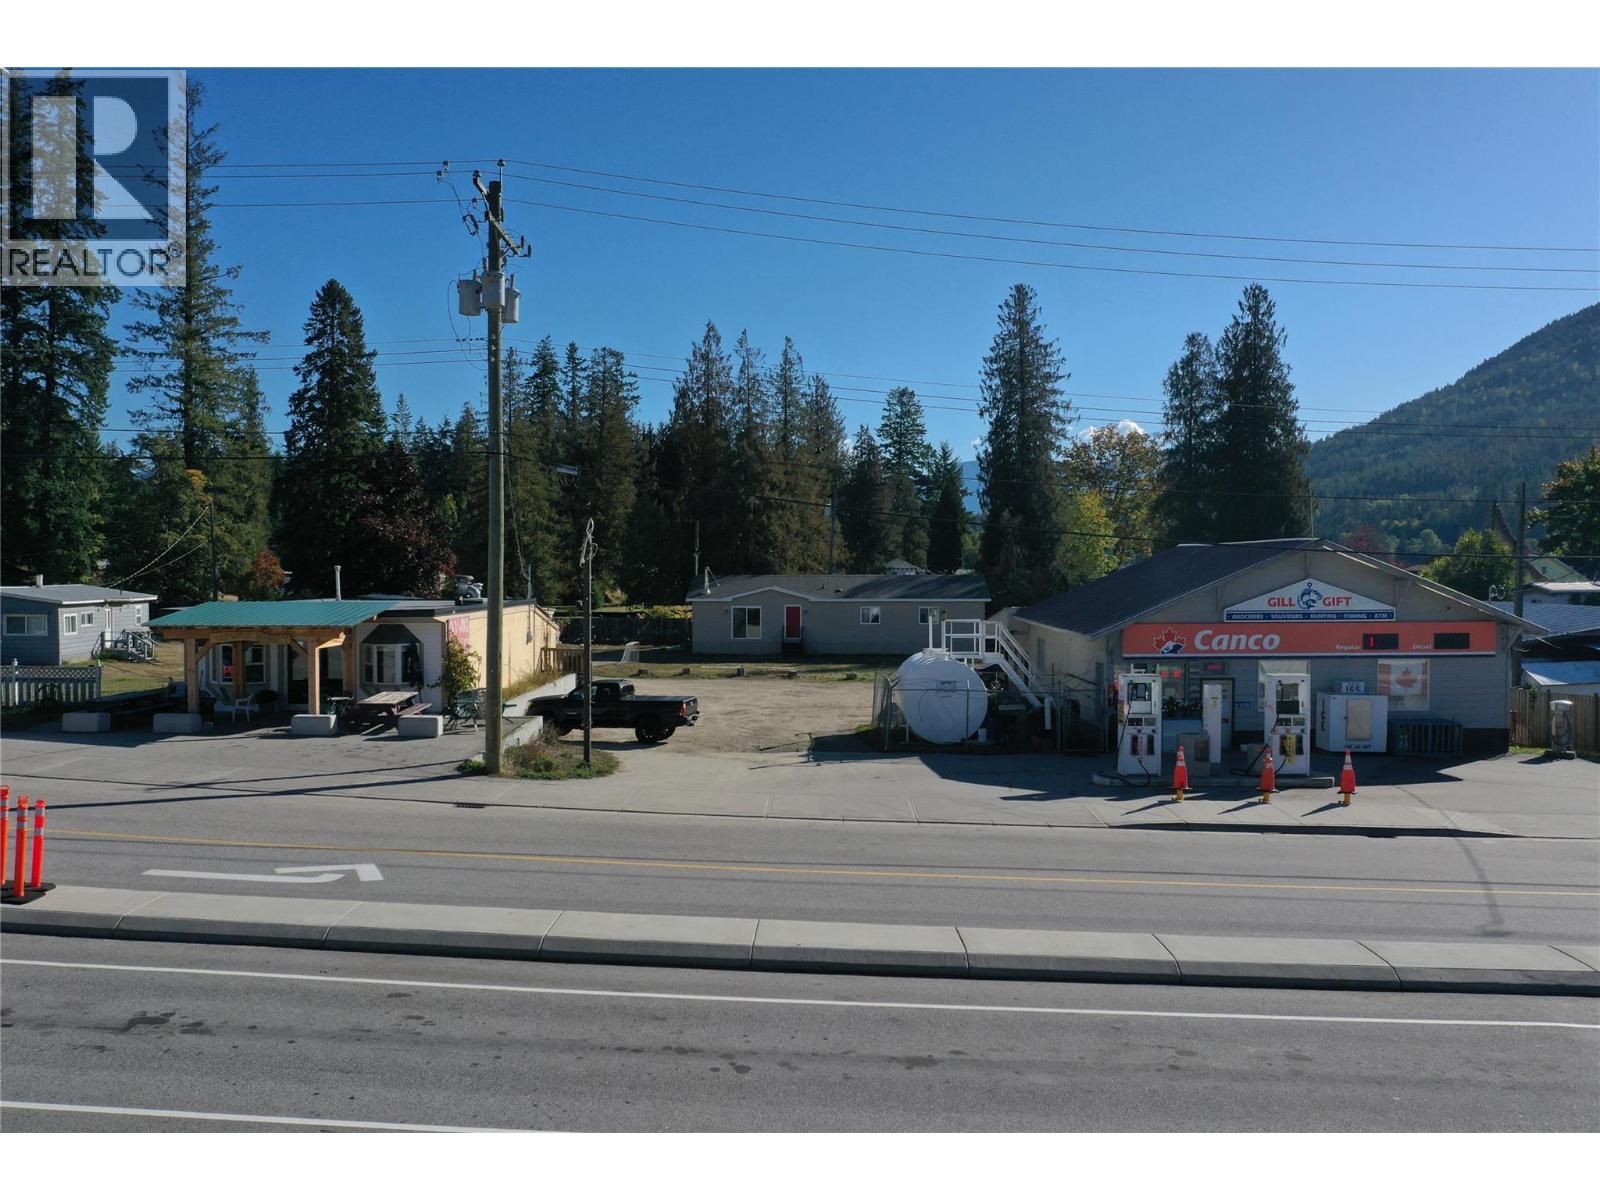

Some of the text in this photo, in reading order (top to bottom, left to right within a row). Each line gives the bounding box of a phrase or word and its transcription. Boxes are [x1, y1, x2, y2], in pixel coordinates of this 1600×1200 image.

[1267, 597, 1352, 607] GILL GIFT
[1194, 629, 1281, 651] Canco
[1335, 643, 1361, 651] Regular
